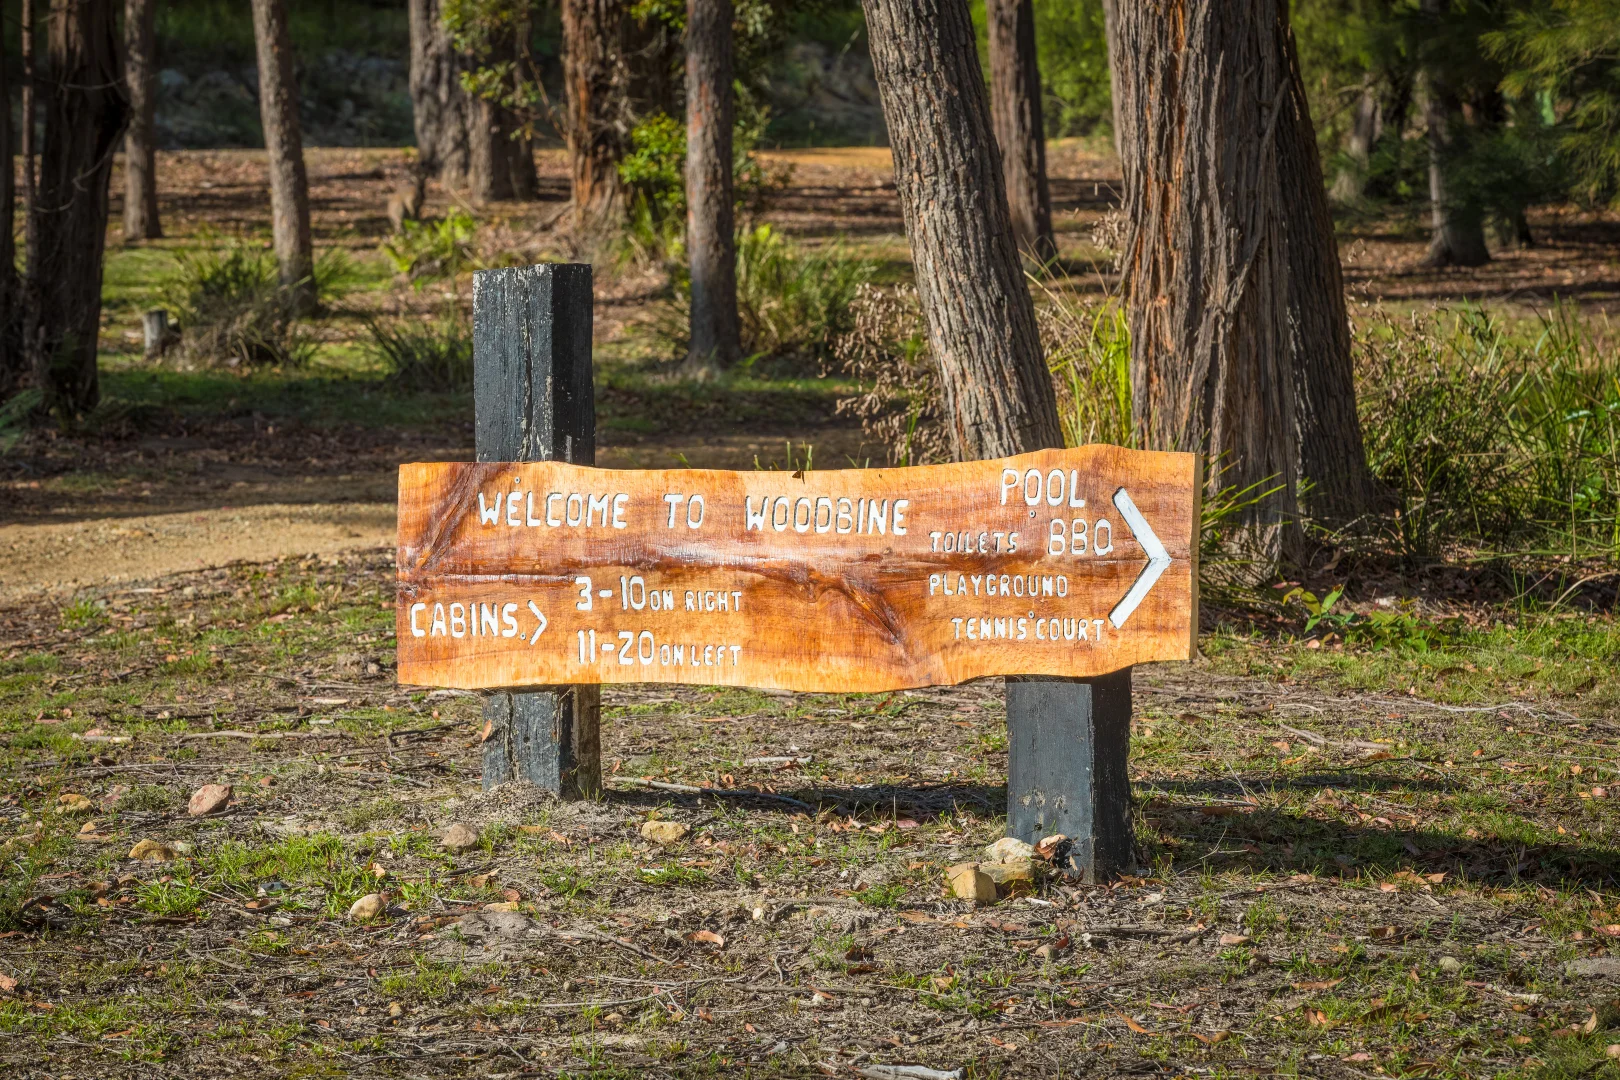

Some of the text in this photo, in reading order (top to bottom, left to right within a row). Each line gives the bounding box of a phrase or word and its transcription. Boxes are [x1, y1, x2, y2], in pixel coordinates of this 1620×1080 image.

[1000, 467, 1086, 508] POOL
[477, 490, 910, 536] WELCOME TO WOODBINE
[929, 518, 1114, 556] TOILETS BBQ
[649, 589, 674, 611] ON
[684, 590, 742, 612] RIGHT
[928, 573, 1068, 598] PLAYGROUND
[410, 601, 519, 638] CABINS
[950, 616, 1105, 642] TENNIS COURT
[659, 644, 684, 666] ON
[690, 644, 742, 667] LEFT
